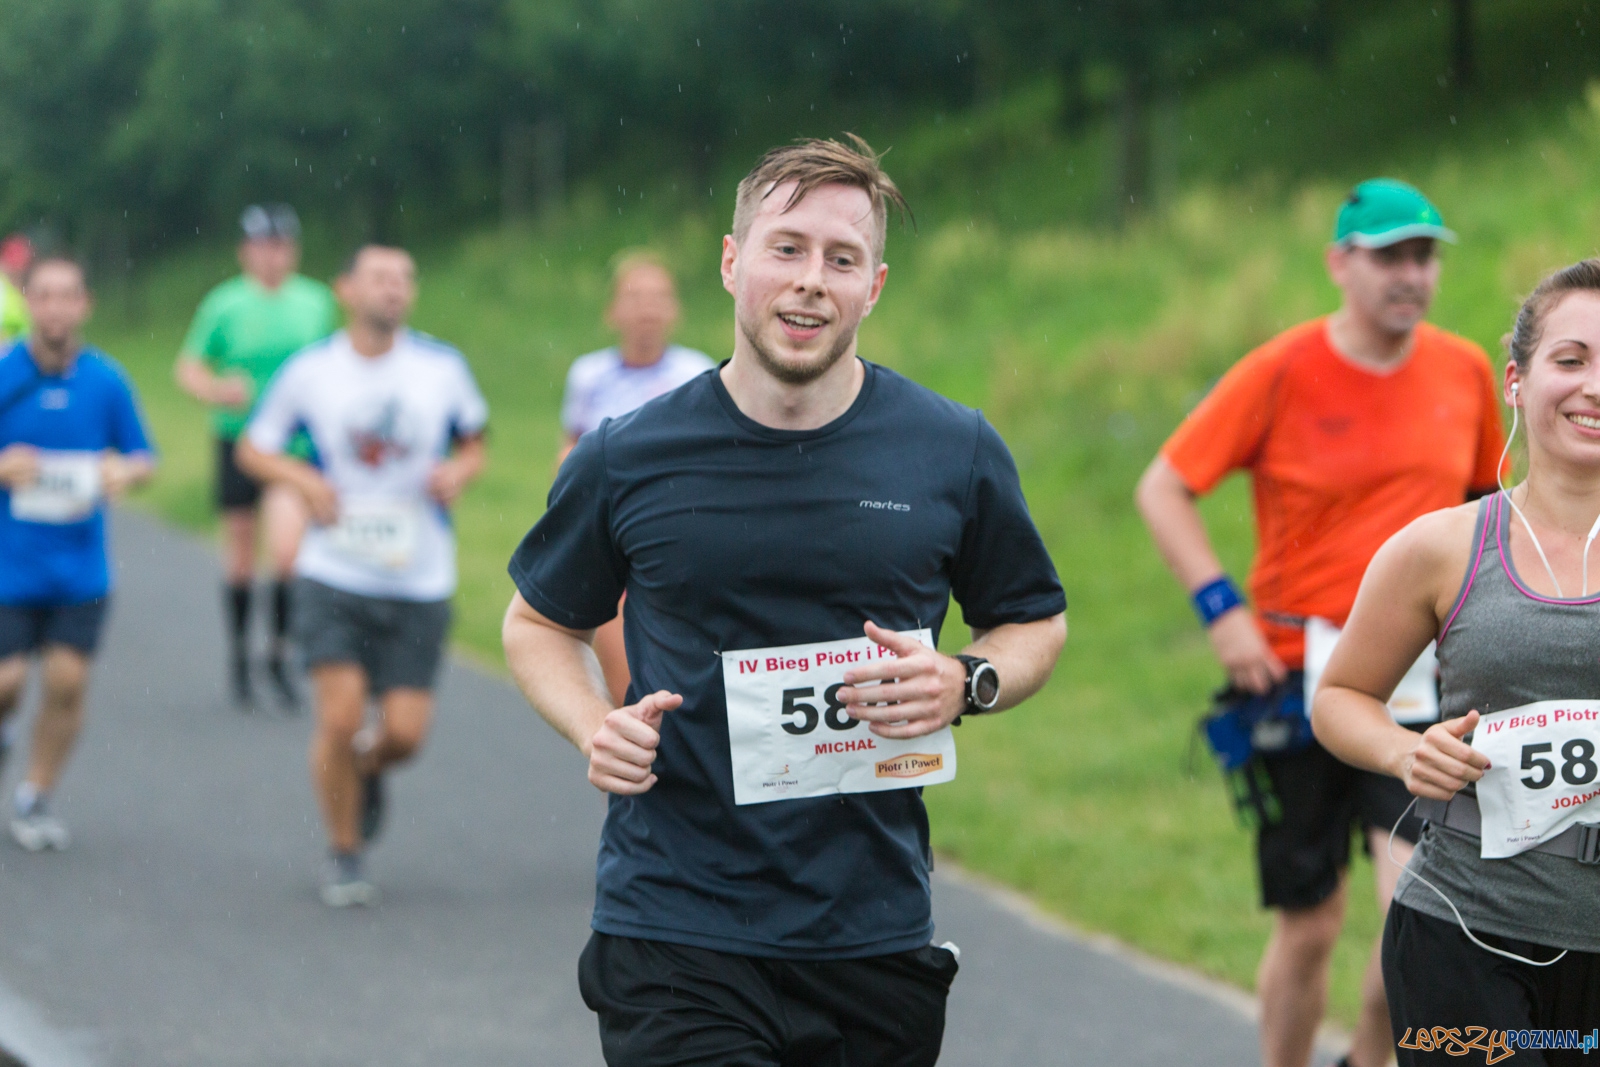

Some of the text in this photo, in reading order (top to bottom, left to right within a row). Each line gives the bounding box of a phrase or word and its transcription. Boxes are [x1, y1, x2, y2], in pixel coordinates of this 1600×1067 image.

[859, 500, 911, 512] martes
[738, 659, 759, 674] IV
[765, 656, 810, 672] Bieg
[815, 648, 861, 667] Piotr
[1487, 708, 1599, 734] IV Bieg Piotr
[814, 738, 877, 756] MICHAŁ
[878, 763, 903, 774] Piotr
